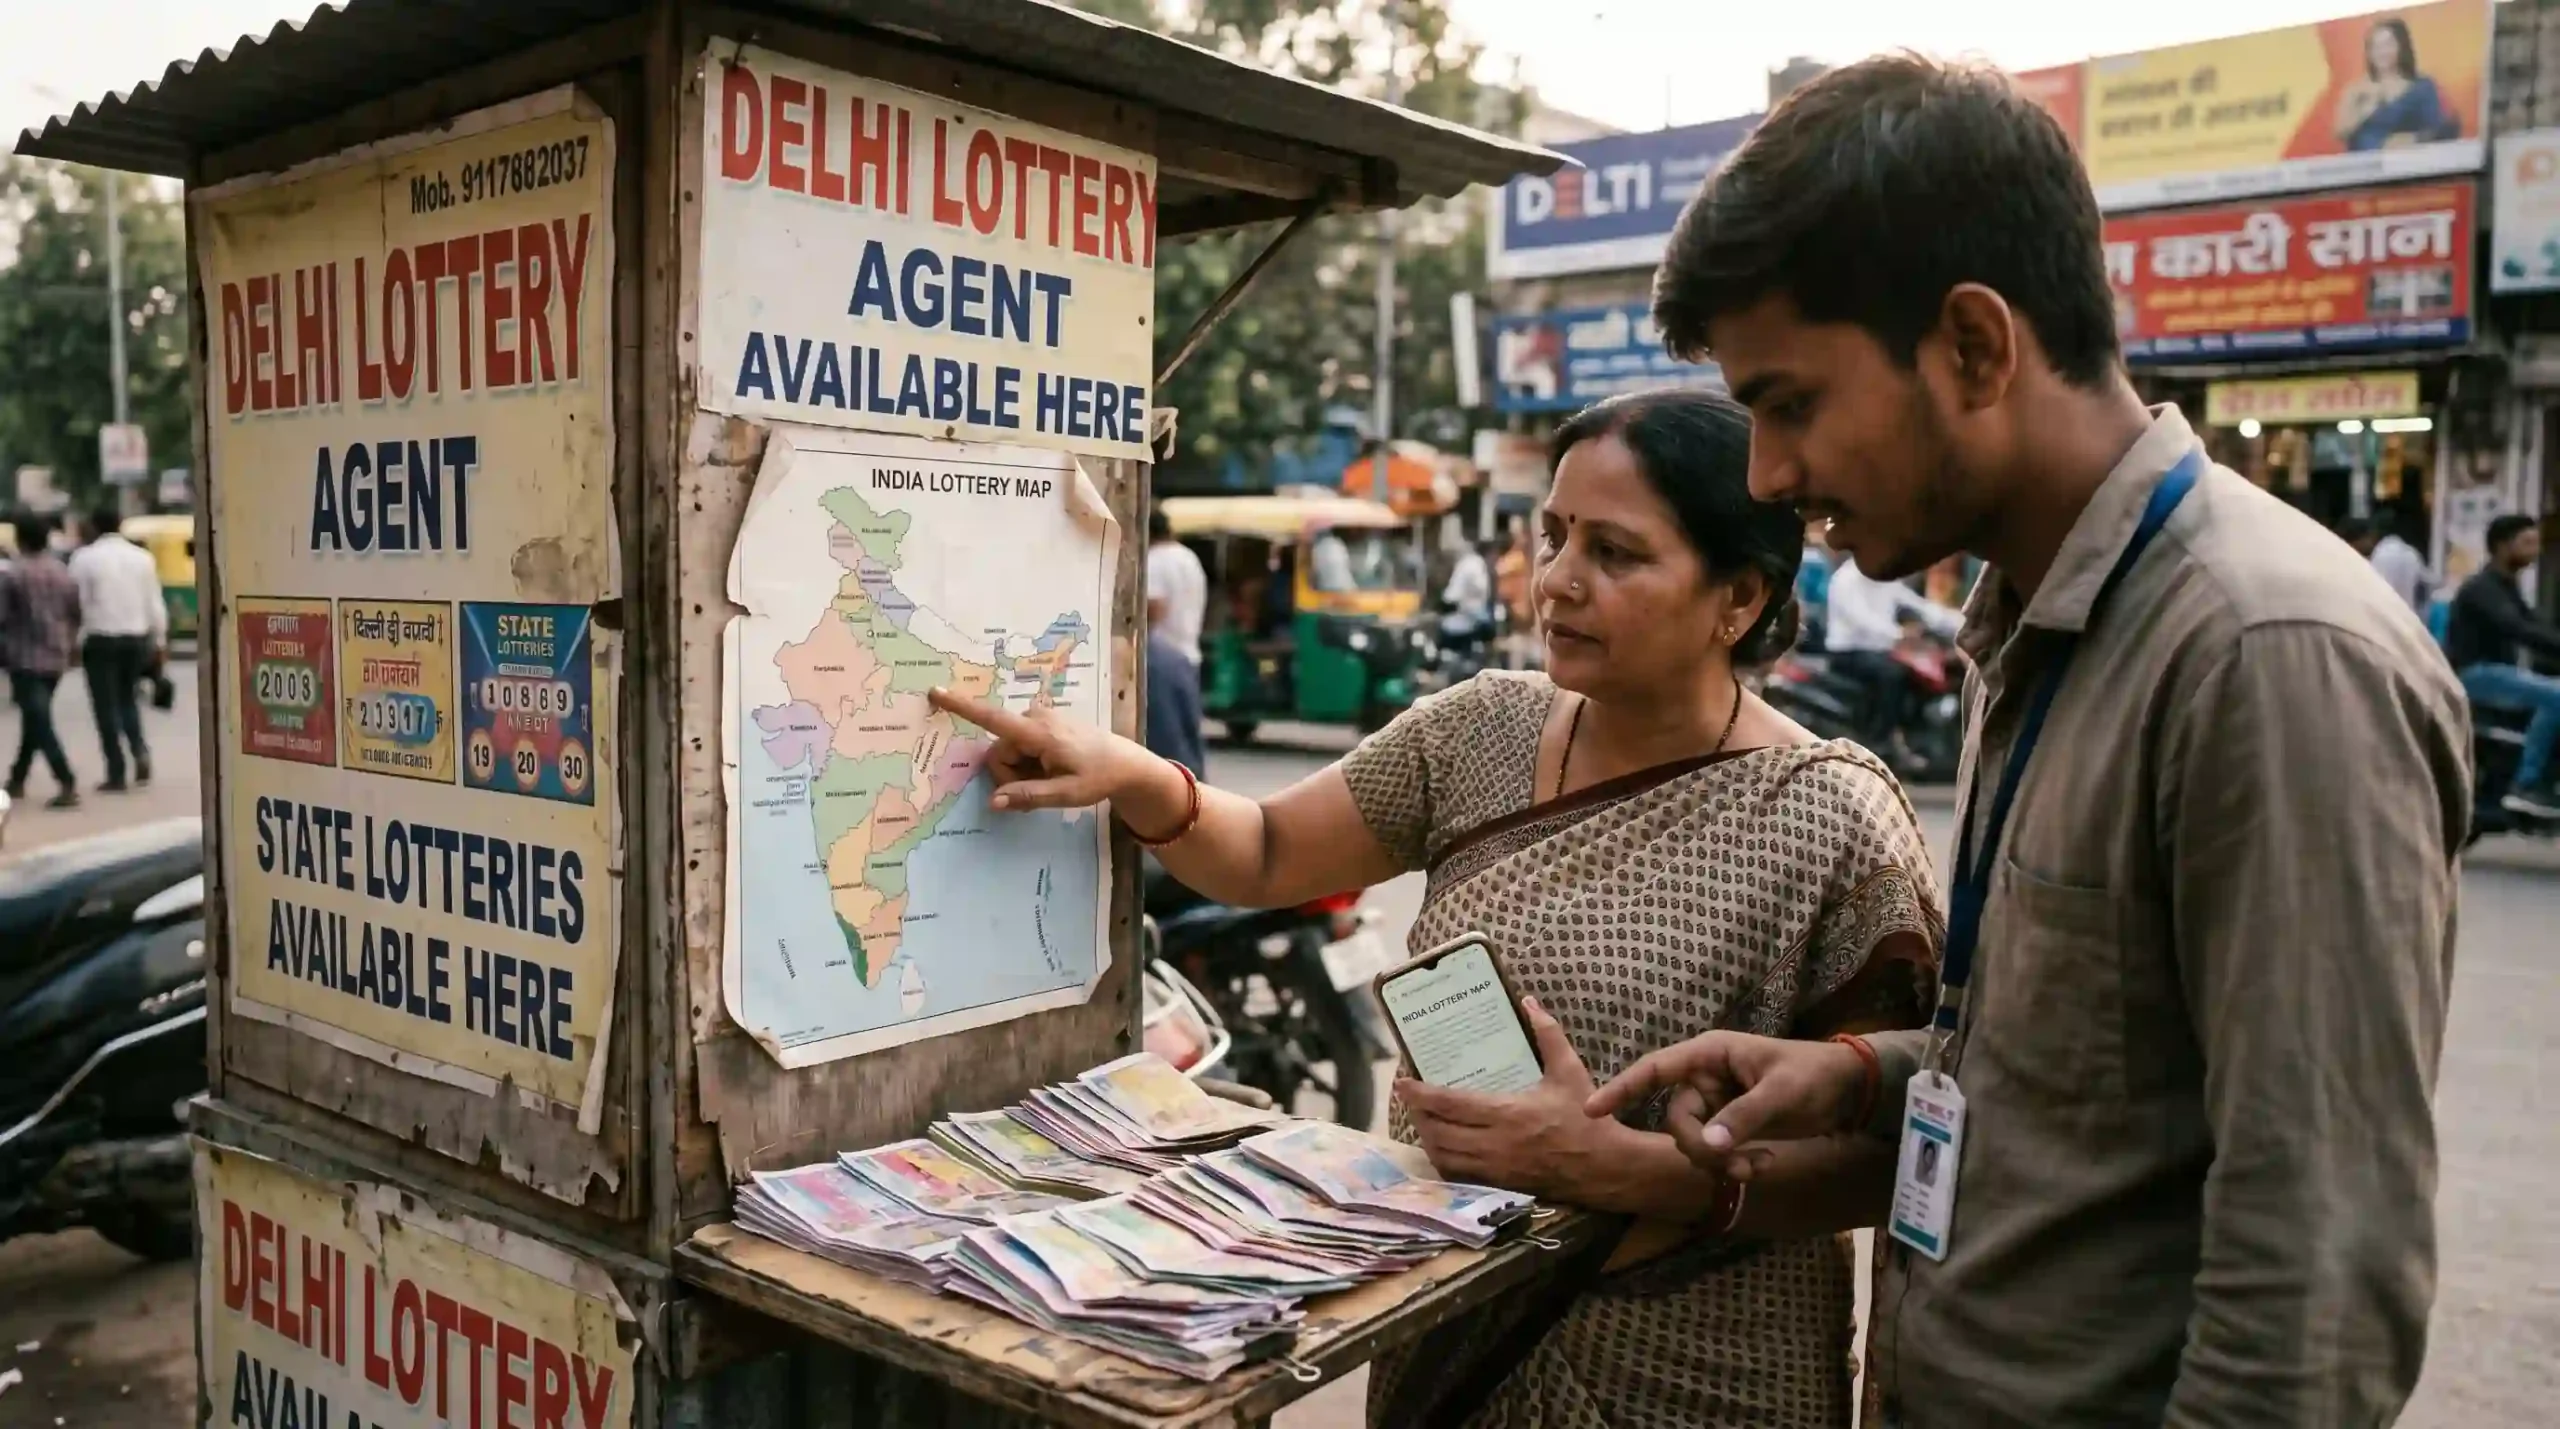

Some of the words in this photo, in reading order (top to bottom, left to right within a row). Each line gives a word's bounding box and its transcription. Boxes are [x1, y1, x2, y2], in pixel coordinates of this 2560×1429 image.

[411, 171, 455, 214] Mob.
[461, 135, 589, 203] 9117882037
[721, 65, 911, 215] DELHI
[933, 118, 1157, 268] LOTTERY
[221, 262, 340, 414] DELHI
[355, 213, 592, 401] LOTTERY
[848, 240, 1072, 347] AGENT
[735, 331, 1021, 429] AVAILABLE
[1037, 372, 1145, 444] HERE
[311, 436, 477, 551] AGENT
[872, 468, 925, 493] INDIA
[930, 472, 1011, 498] LOTTERY
[1016, 478, 1053, 499] MAP
[497, 640, 555, 657] LOTTERIES
[498, 615, 555, 638] STATE
[473, 743, 490, 767] 19
[517, 751, 535, 775] 20
[564, 756, 582, 780] 30
[256, 796, 354, 891] STATE
[365, 815, 584, 944] LOTTERIES
[267, 898, 451, 1024] AVAILABLE
[464, 946, 573, 1061] HERE
[1402, 1007, 1428, 1024] INDIA
[1429, 989, 1469, 1014] LOTTERY
[1470, 980, 1492, 996] MAP
[223, 1200, 346, 1367] DELHI
[364, 1264, 614, 1429] LOTTERY
